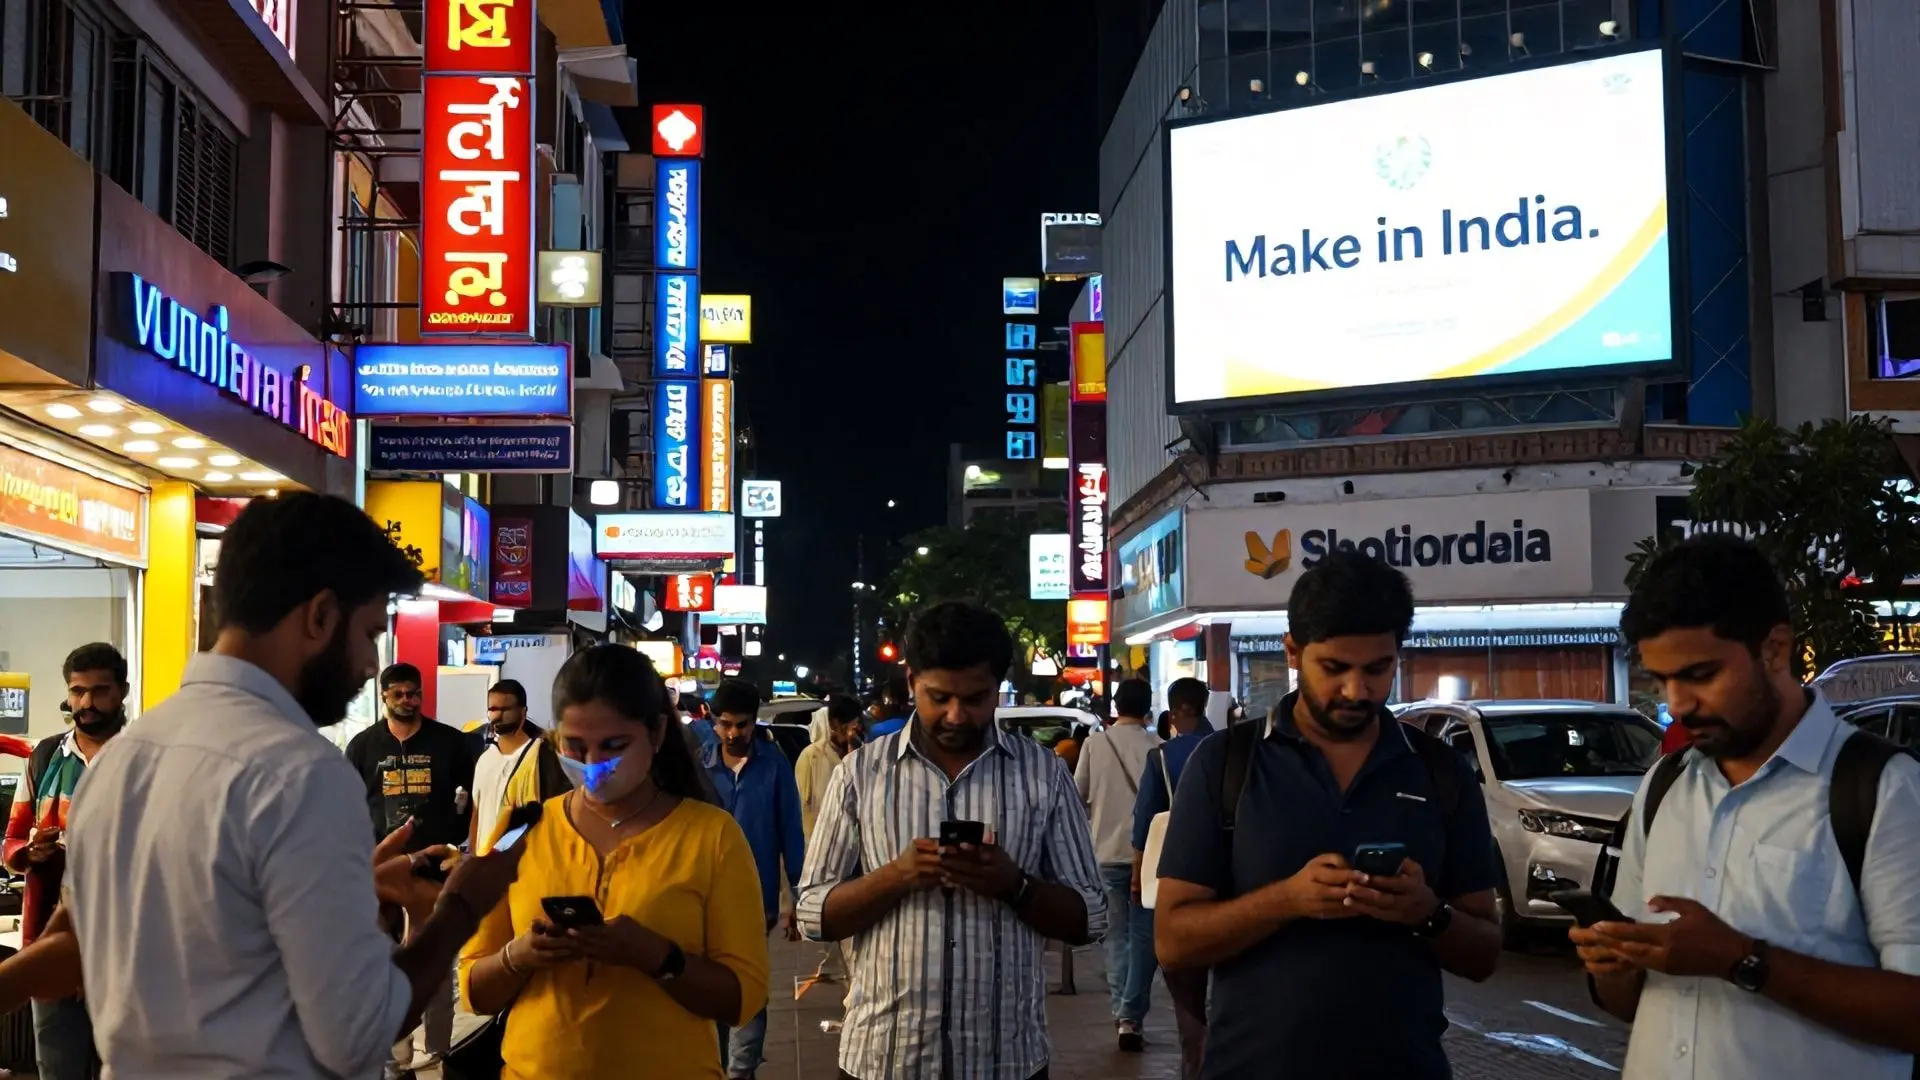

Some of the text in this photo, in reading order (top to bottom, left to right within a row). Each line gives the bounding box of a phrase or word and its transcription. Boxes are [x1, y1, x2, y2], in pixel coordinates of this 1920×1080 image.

[1225, 194, 1600, 282] Make in India.
